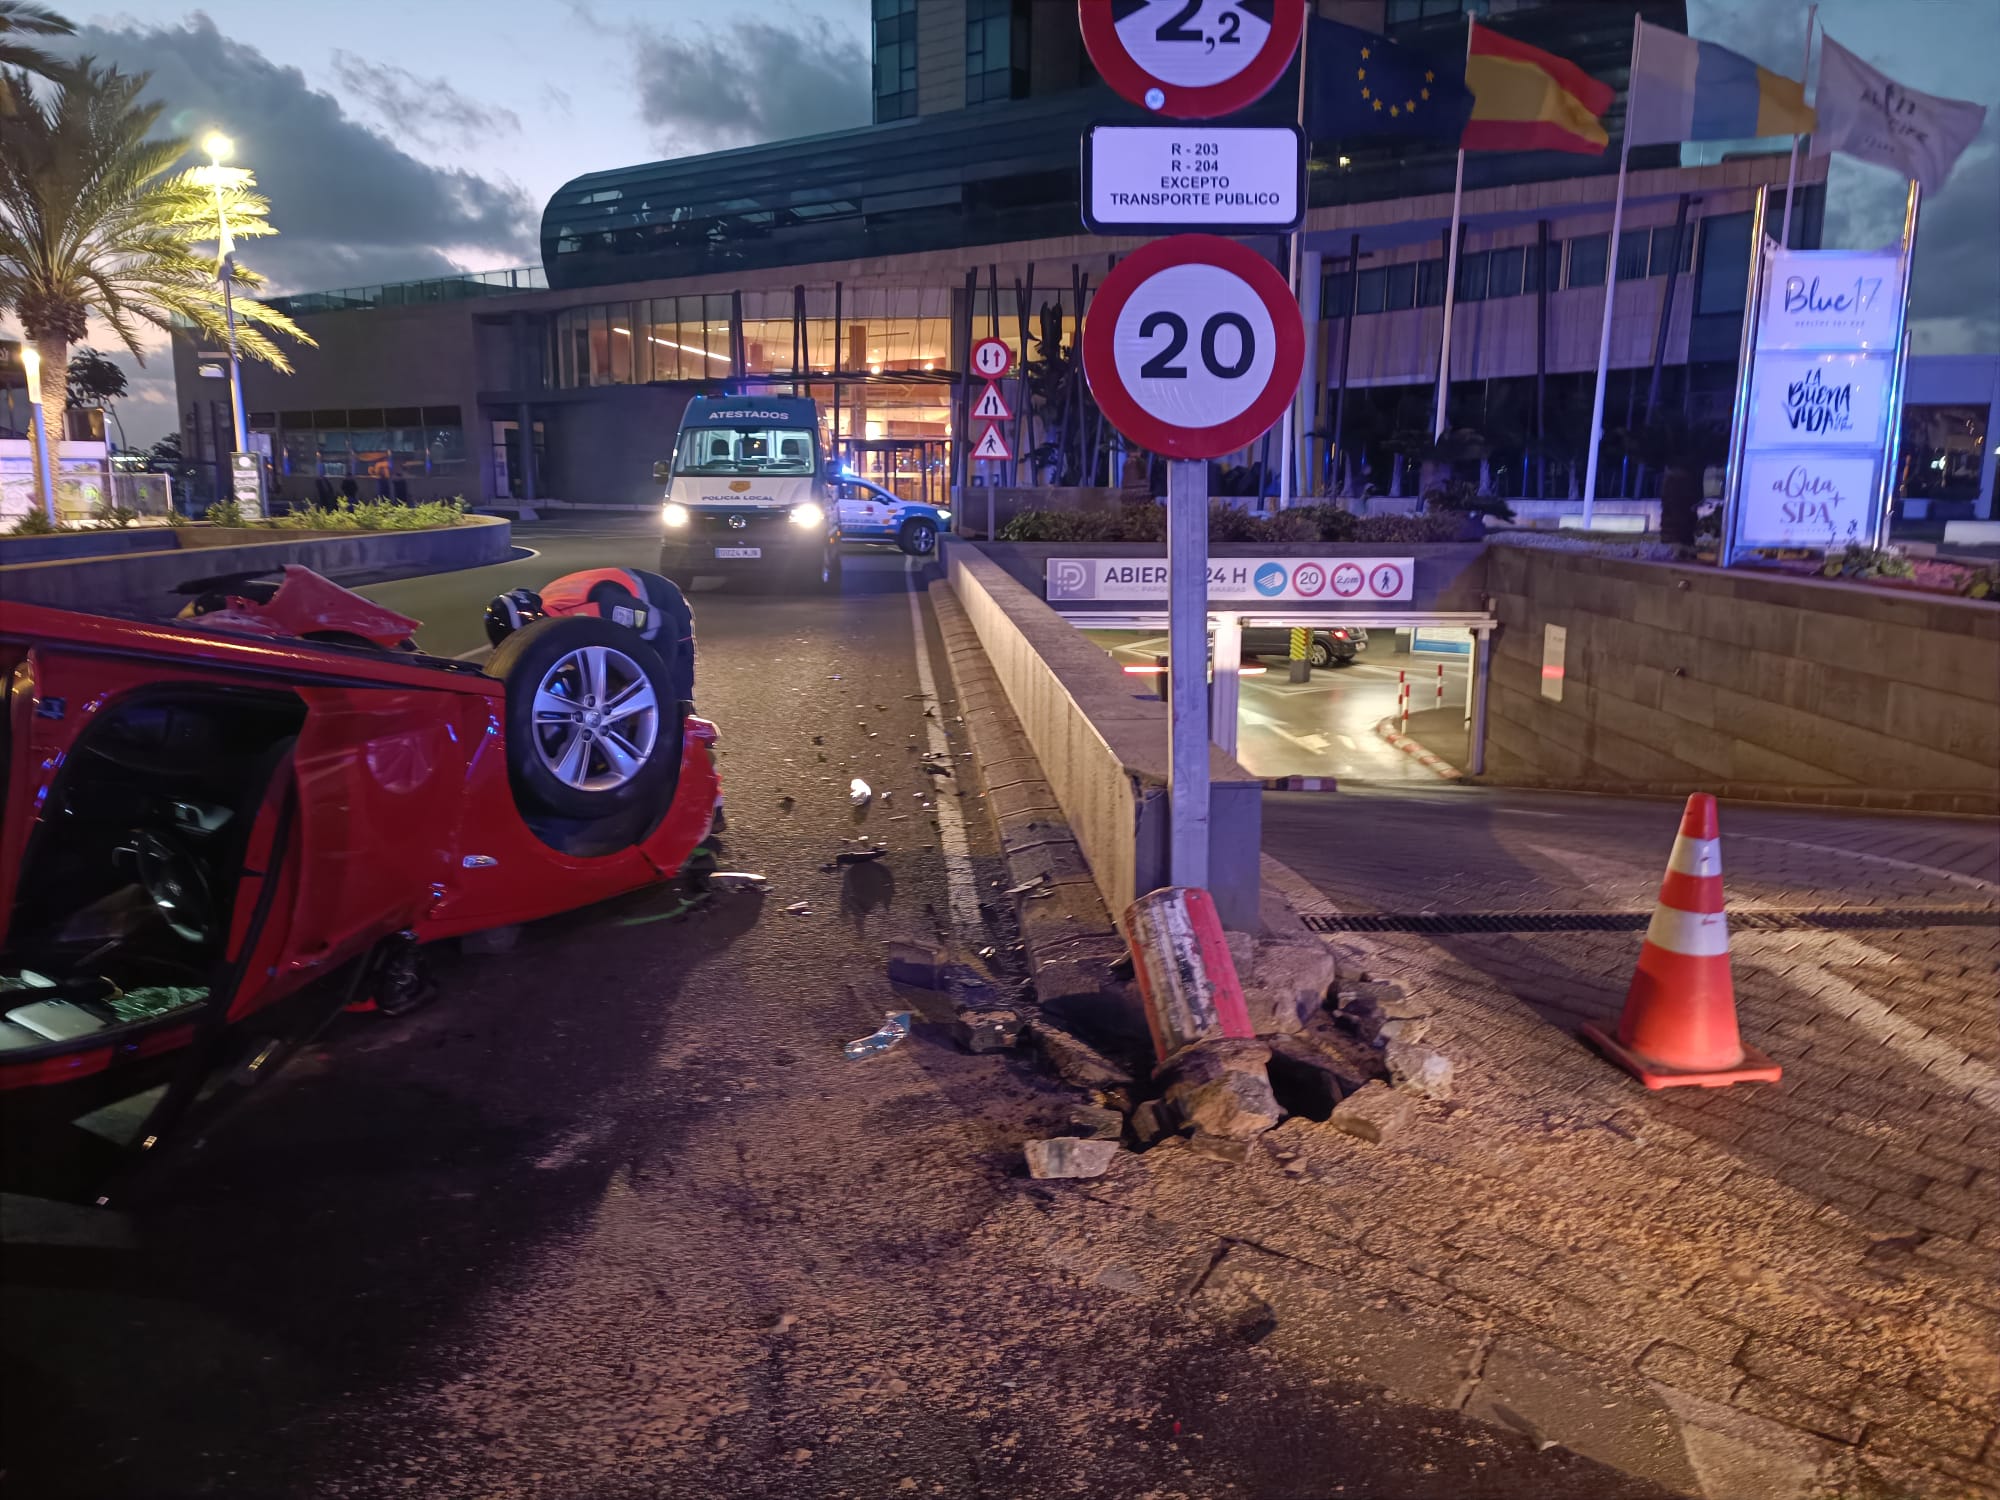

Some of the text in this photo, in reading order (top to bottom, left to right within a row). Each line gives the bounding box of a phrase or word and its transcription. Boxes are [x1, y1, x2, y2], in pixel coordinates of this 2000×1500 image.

[1171, 143, 1182, 156] R
[1195, 143, 1219, 156] 203
[1171, 160, 1182, 172] R
[1195, 160, 1219, 172] 204
[1161, 176, 1230, 189] EXCEPTO
[1110, 192, 1280, 206] TRANSPORTE PUBLICO
[1138, 310, 1256, 380] 20
[709, 410, 790, 420] ATESTADOS
[1232, 567, 1247, 584] H
[1299, 571, 1319, 585] 20
